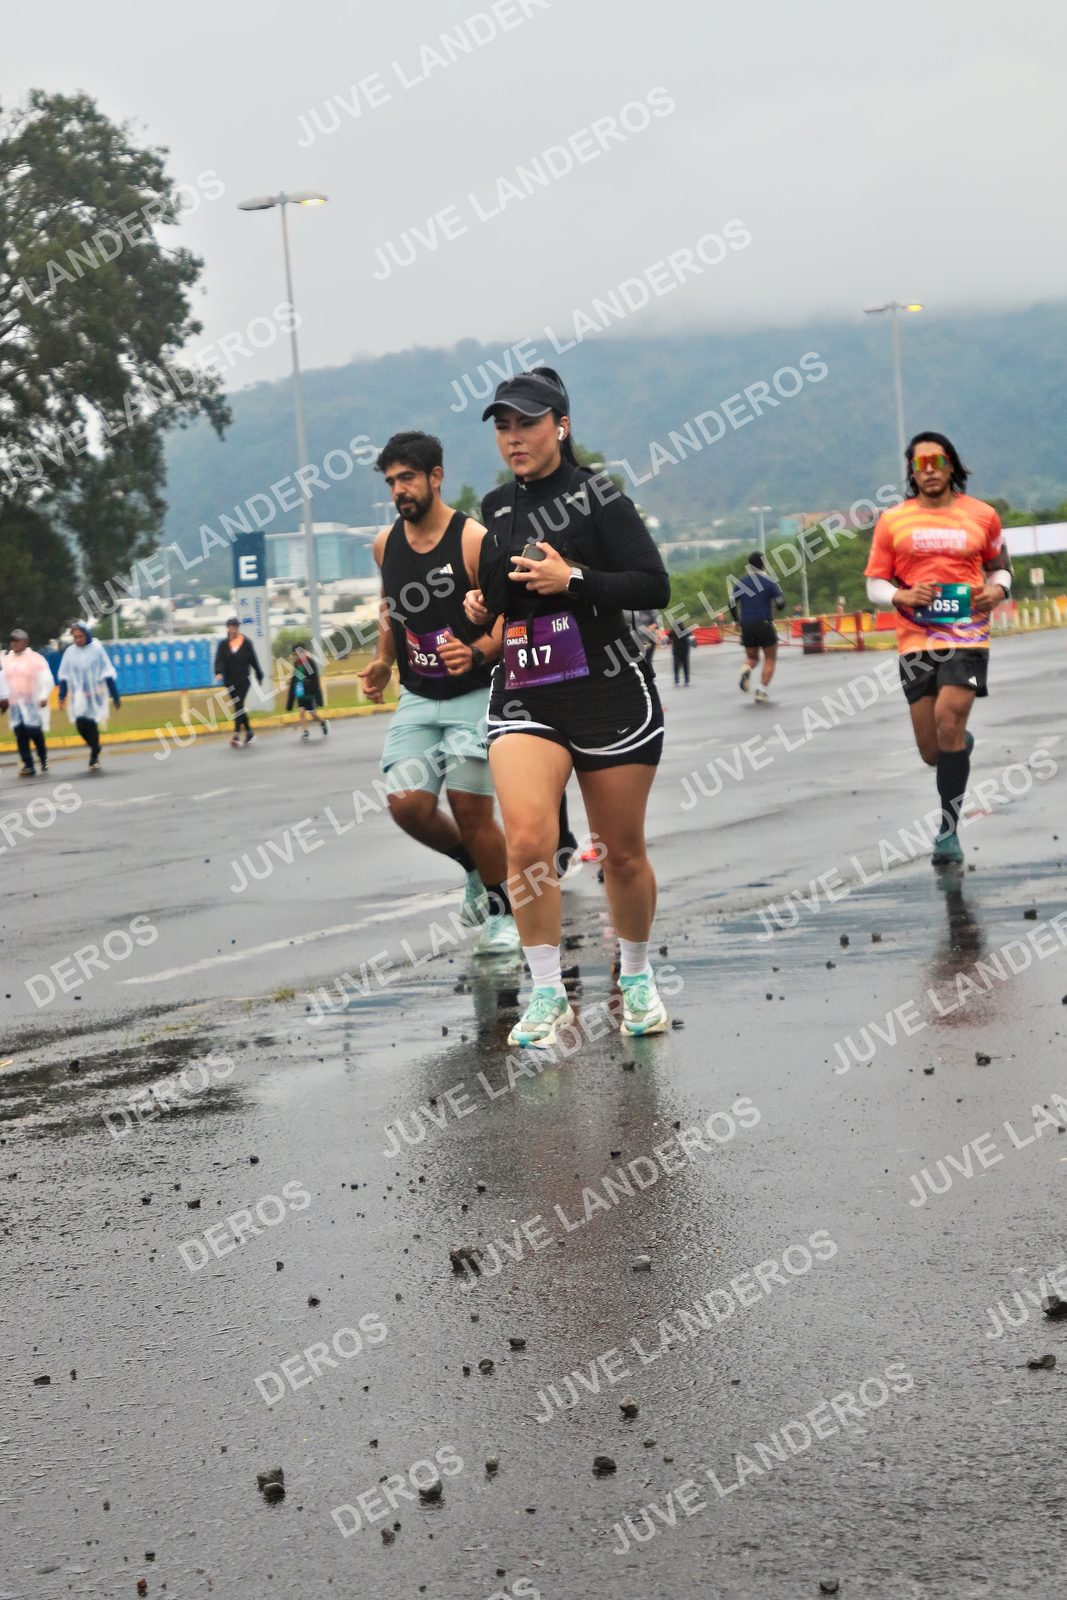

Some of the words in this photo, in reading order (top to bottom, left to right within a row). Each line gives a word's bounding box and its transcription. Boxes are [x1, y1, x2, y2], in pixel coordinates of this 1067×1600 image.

[239, 555, 258, 579] E
[551, 616, 570, 632] 15K
[436, 633, 447, 645] 15
[518, 645, 552, 668] 817
